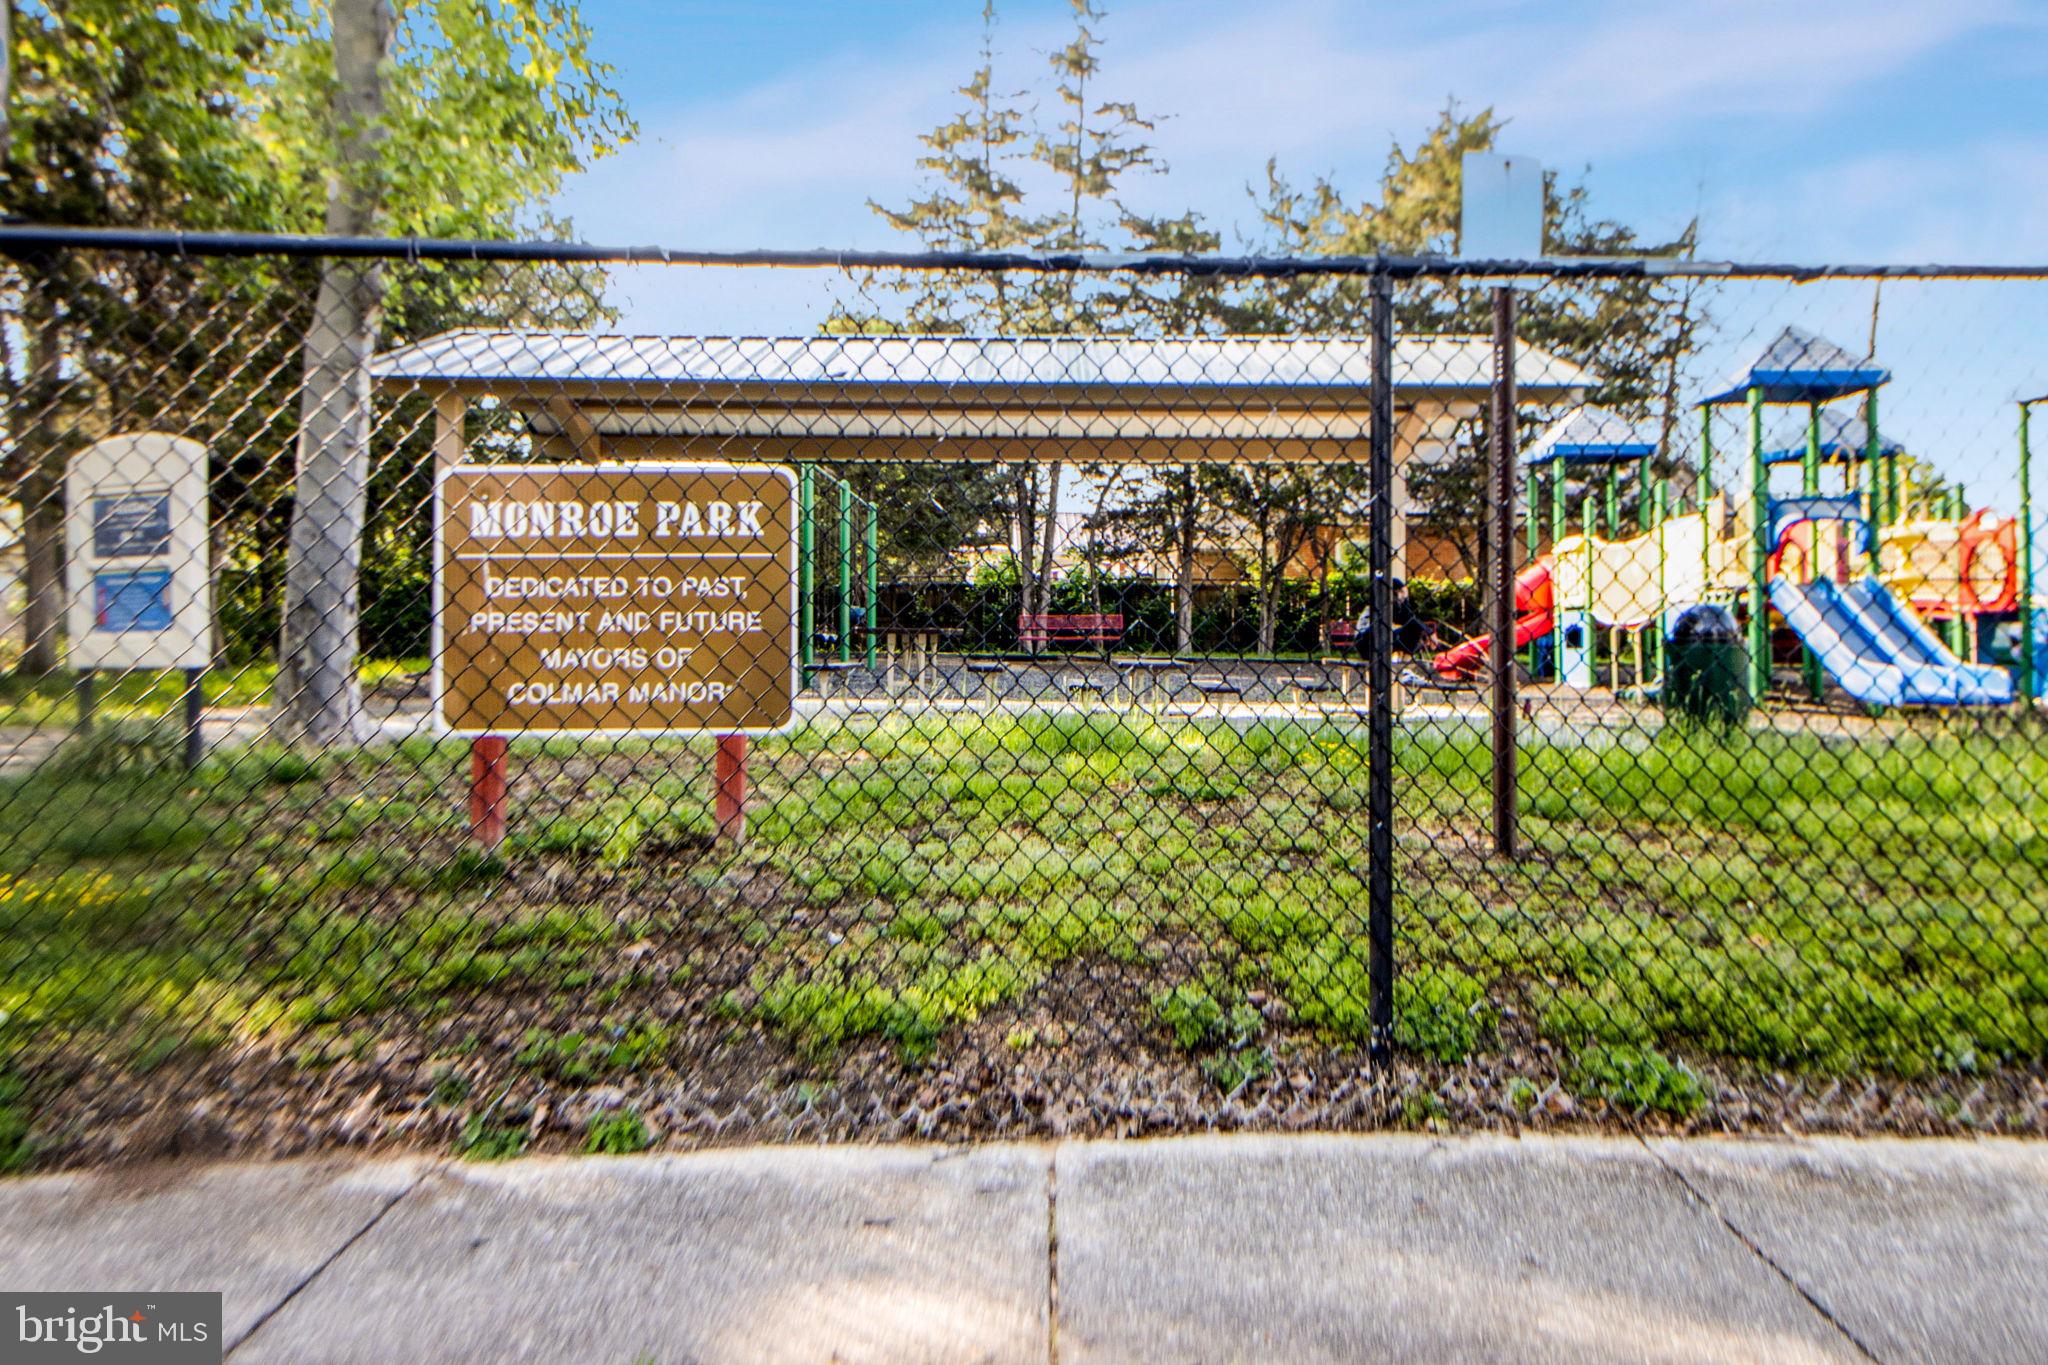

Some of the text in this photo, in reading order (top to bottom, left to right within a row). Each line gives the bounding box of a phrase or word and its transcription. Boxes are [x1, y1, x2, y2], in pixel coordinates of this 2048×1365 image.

[469, 500, 765, 539] MONROE PARK
[484, 576, 630, 599] DEDICATED
[637, 577, 672, 598] TO
[470, 611, 762, 634] PRESENT AND FUTURE
[540, 648, 693, 670] MAYORS OF
[506, 682, 619, 705] COLMAR
